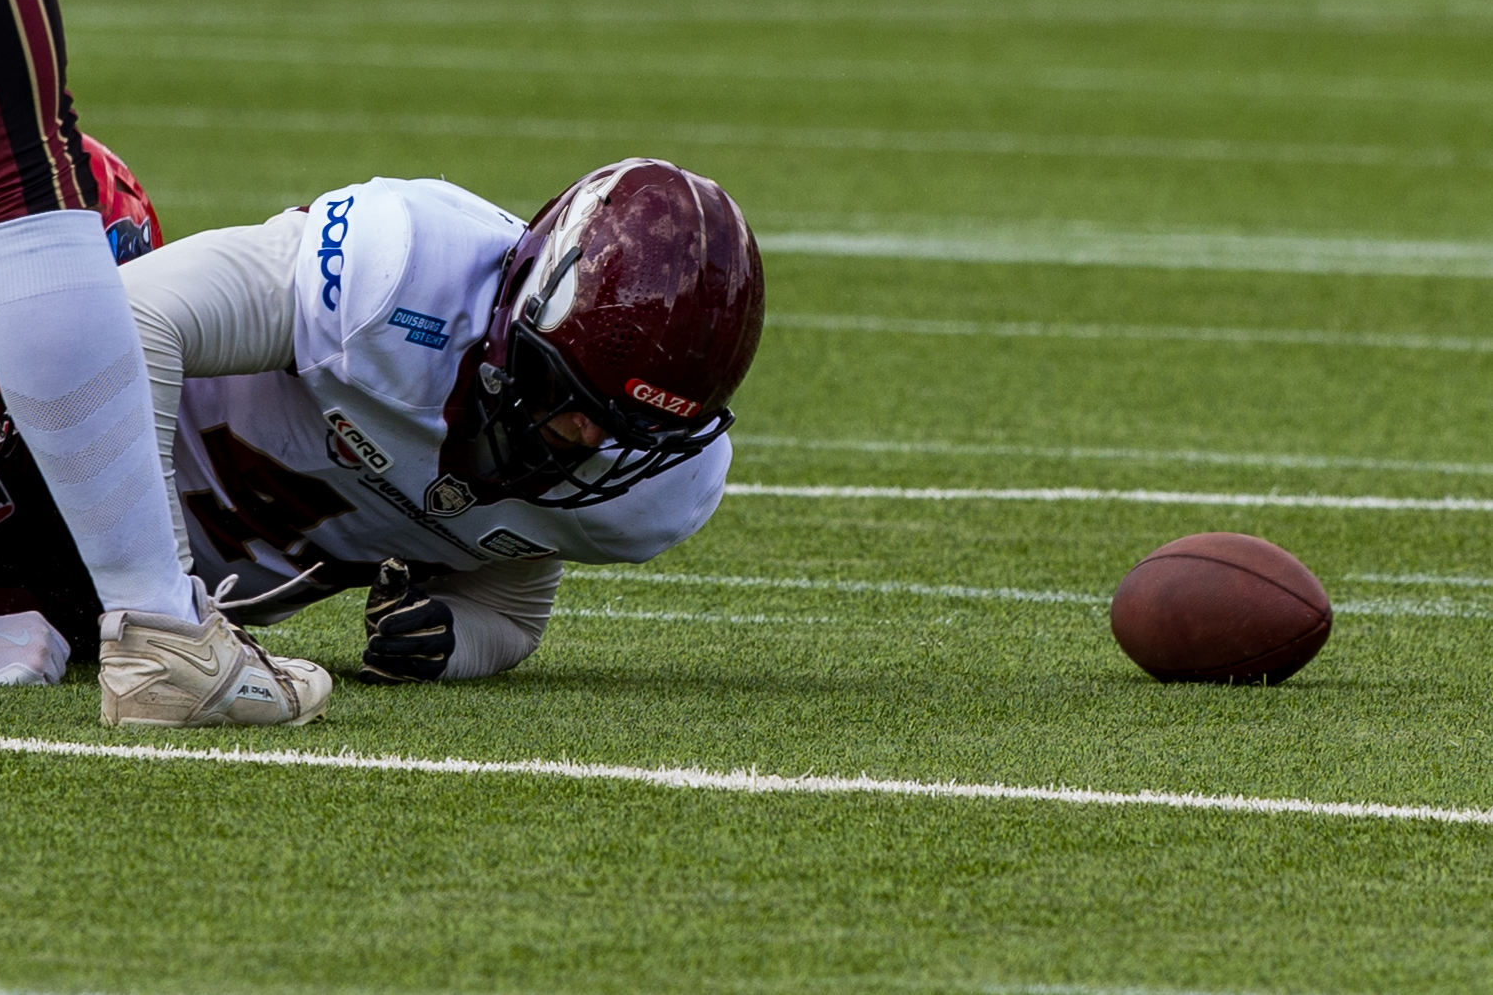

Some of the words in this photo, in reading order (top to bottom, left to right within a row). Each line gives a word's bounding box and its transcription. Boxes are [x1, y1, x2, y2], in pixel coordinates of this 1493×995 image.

[393, 311, 441, 332] DUISBURG
[410, 330, 426, 342] IST
[424, 334, 445, 346] ECHT
